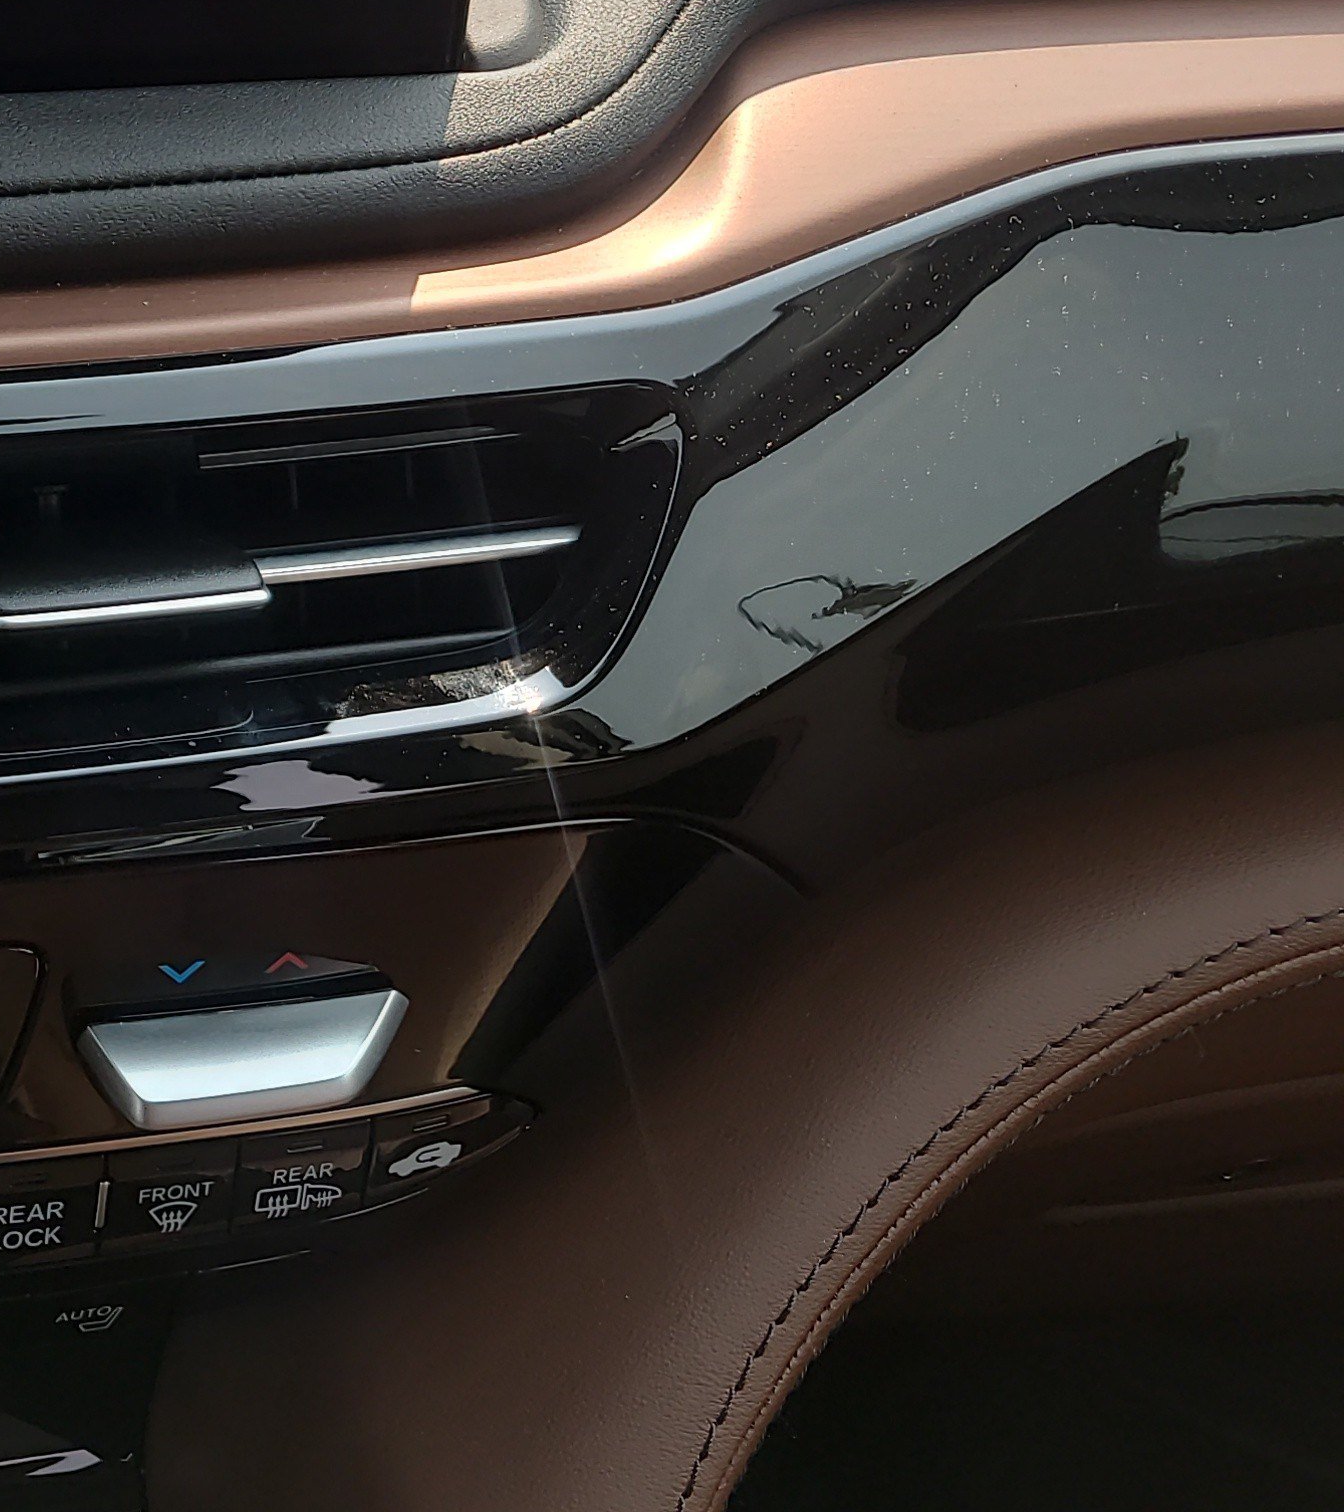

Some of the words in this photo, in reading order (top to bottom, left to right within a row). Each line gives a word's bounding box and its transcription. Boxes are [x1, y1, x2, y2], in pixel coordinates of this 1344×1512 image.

[273, 1163, 334, 1185] REAR
[139, 1182, 214, 1204] FRONT
[56, 1305, 114, 1322] AUTO
